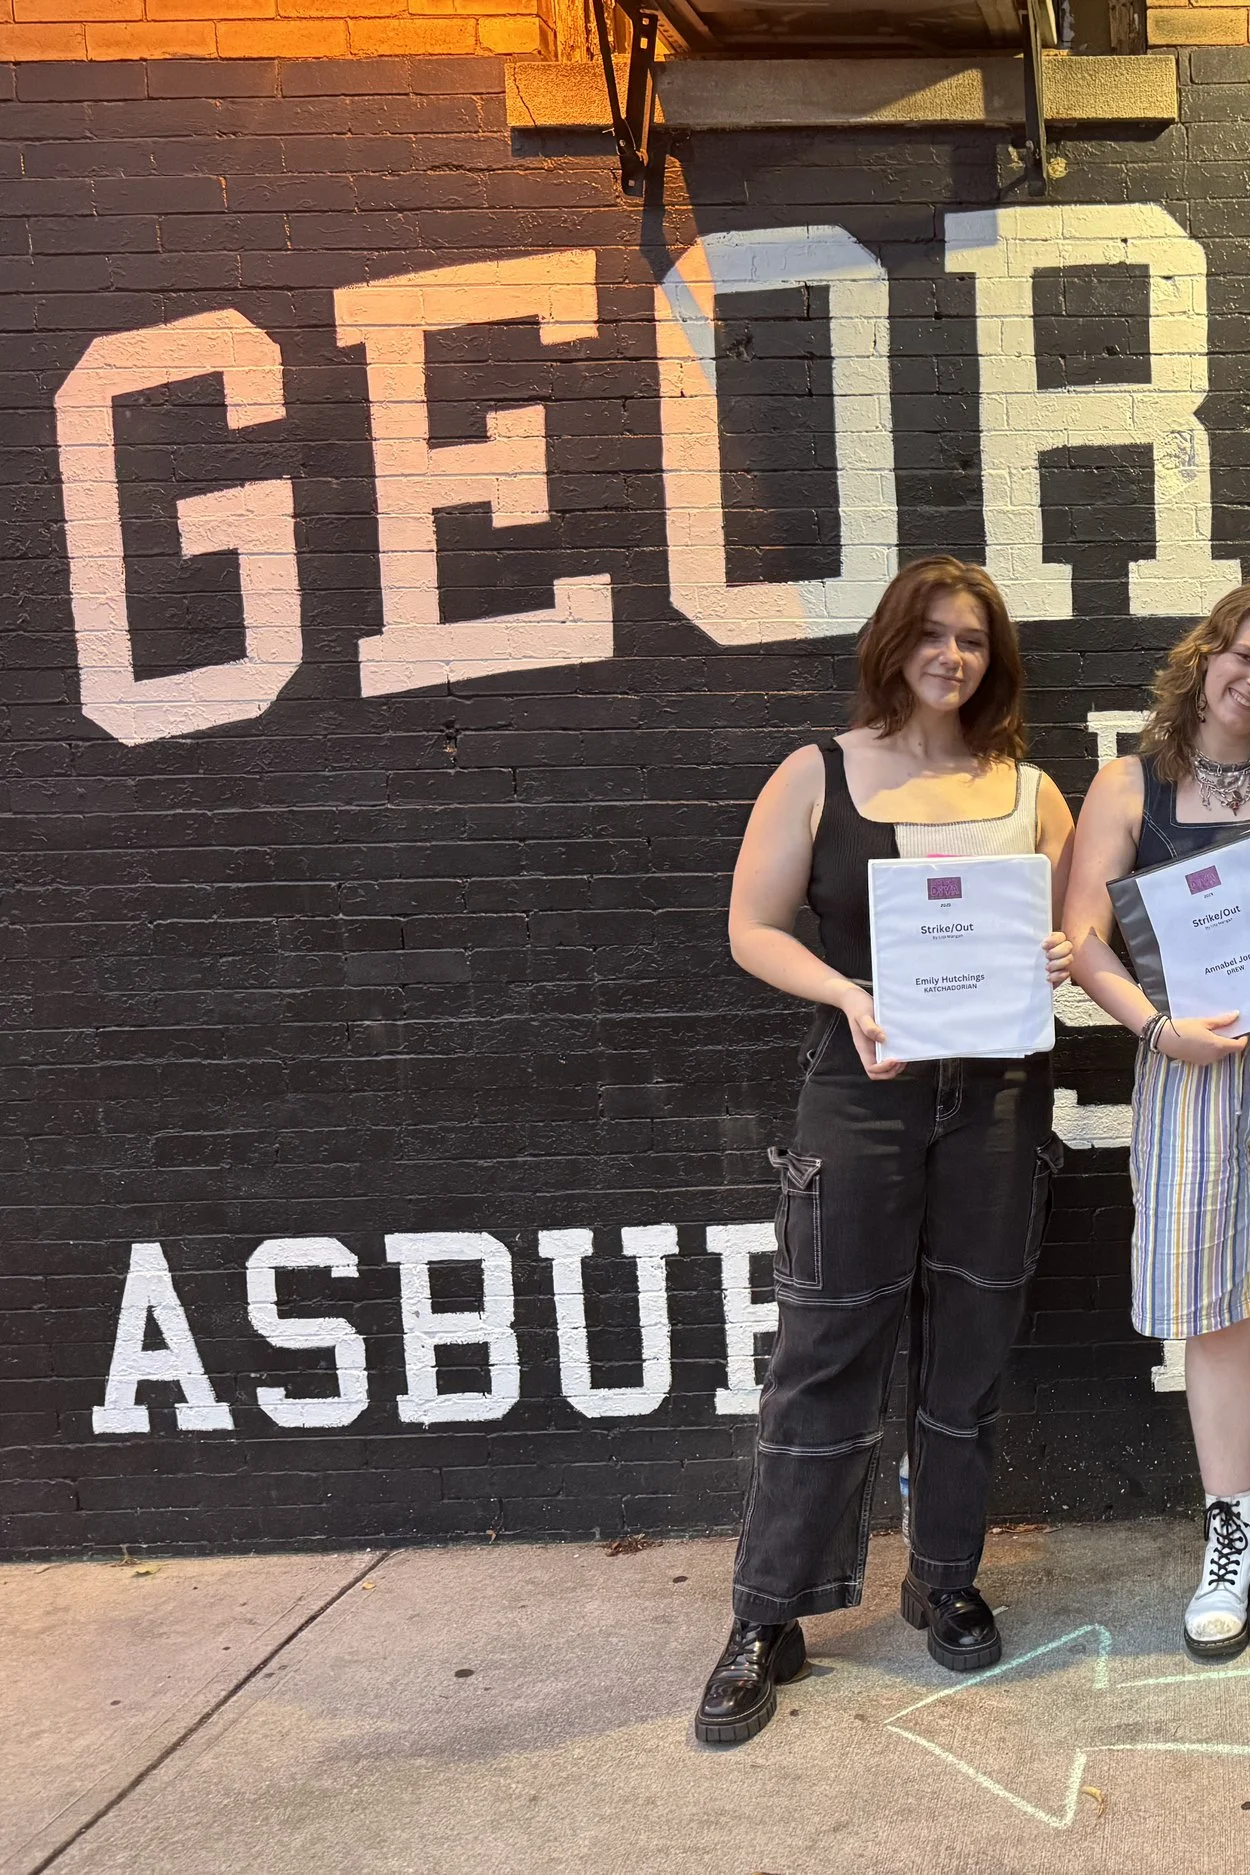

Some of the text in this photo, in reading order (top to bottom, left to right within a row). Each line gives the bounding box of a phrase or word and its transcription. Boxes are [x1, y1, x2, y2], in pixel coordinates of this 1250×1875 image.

[1192, 905, 1241, 928] Strike/Out
[920, 923, 974, 935] Strike/Out
[1204, 957, 1238, 975] Annabel
[1226, 964, 1246, 976] DREW
[915, 973, 986, 987] Emily Hutchings
[923, 983, 978, 993] KATCHADORIAN
